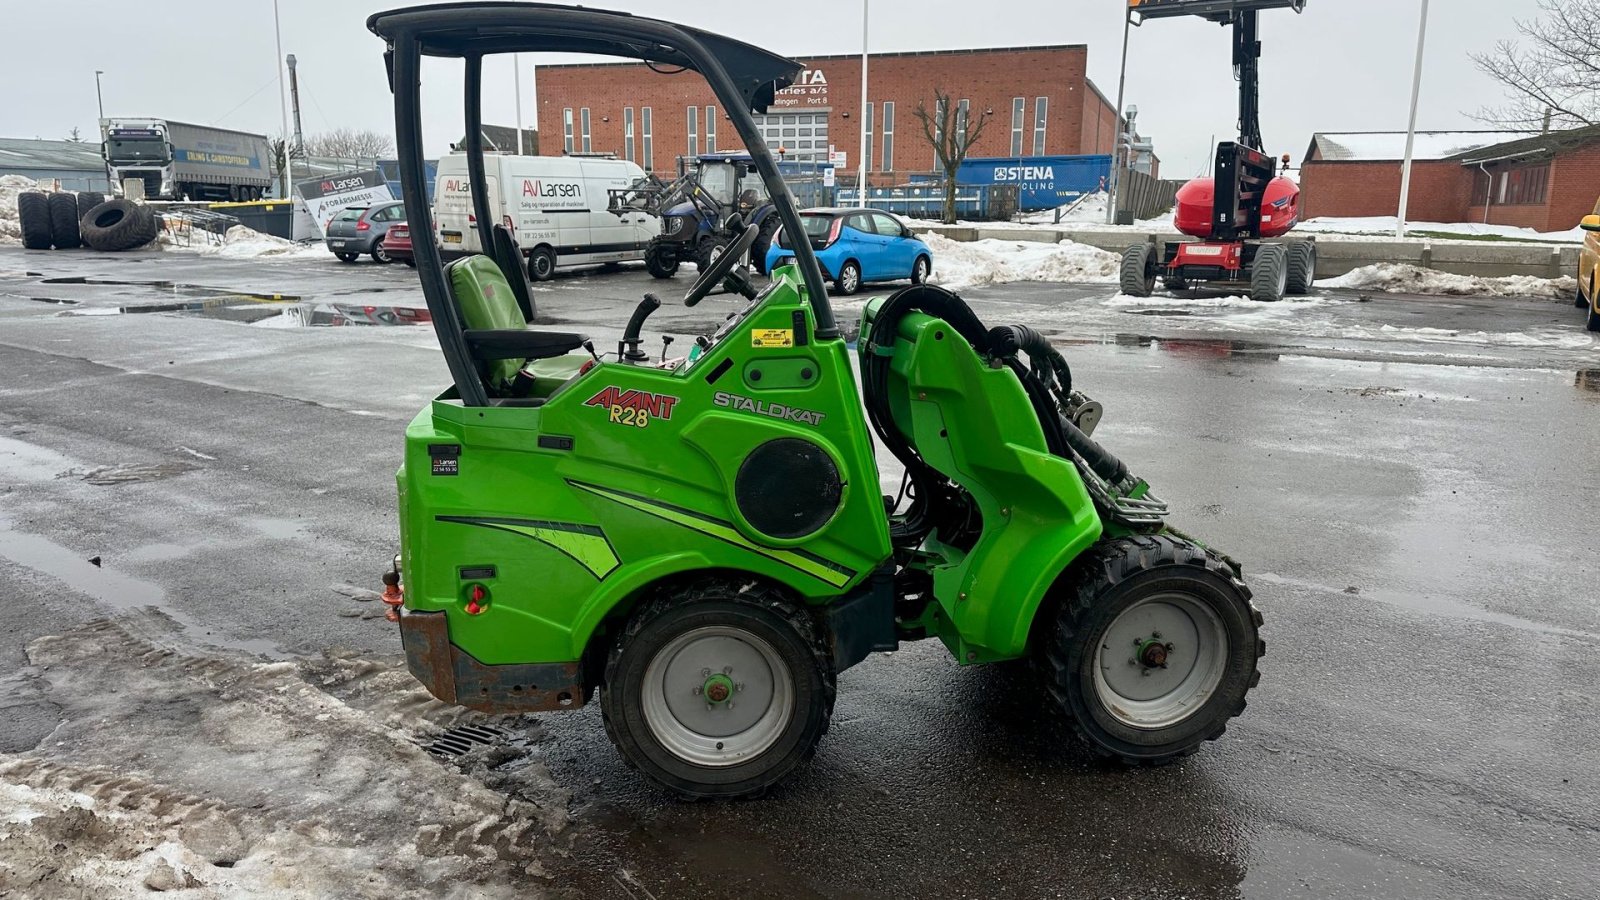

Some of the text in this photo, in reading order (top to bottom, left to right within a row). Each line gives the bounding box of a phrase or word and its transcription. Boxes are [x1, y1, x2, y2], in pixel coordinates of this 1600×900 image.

[801, 69, 828, 85] TA
[775, 86, 828, 95] stries a/s
[774, 98, 799, 107] elingen
[1008, 166, 1054, 180] STENA
[321, 176, 365, 193] AVLarsen
[522, 179, 581, 198] AVLarsen
[325, 192, 374, 208] FORÅRSMESSE
[584, 385, 679, 421] AVANT
[713, 391, 826, 426] STALDKAT
[608, 404, 649, 429] R28
